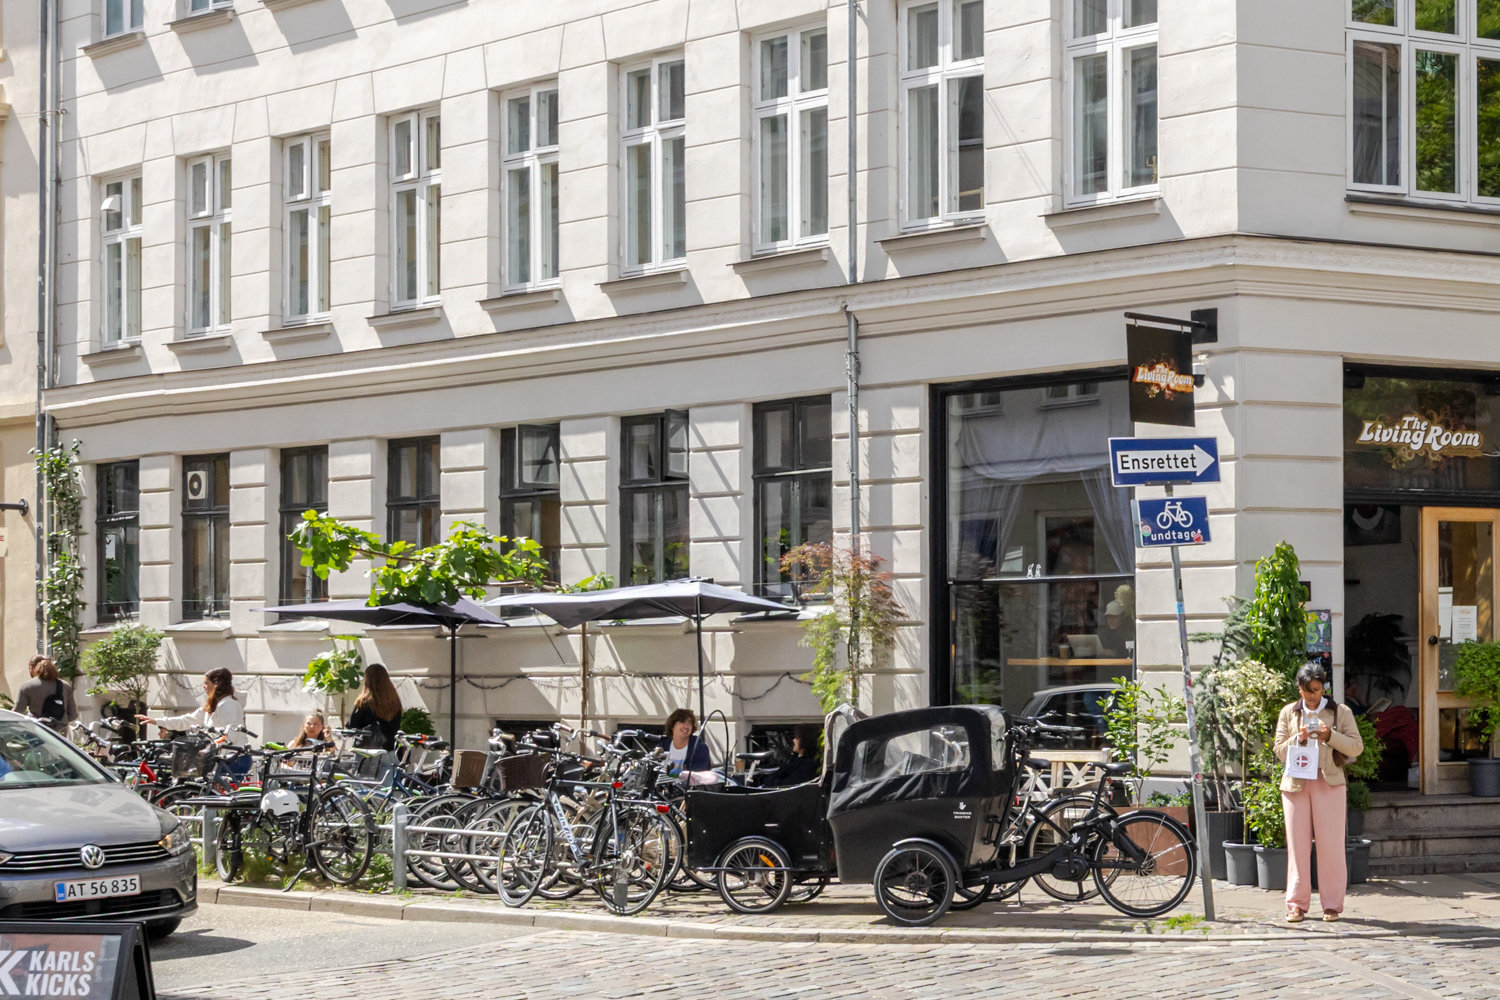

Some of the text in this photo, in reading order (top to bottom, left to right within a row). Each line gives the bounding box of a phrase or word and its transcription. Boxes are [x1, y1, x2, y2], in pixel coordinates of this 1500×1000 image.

[1137, 367, 1192, 388] Living Room
[1402, 416, 1428, 430] The
[1359, 422, 1480, 451] Living Room
[1120, 453, 1197, 470] Ensrettet
[68, 878, 137, 897] AT 56 835
[29, 951, 95, 972] KARLS
[25, 974, 91, 996] KICKS
